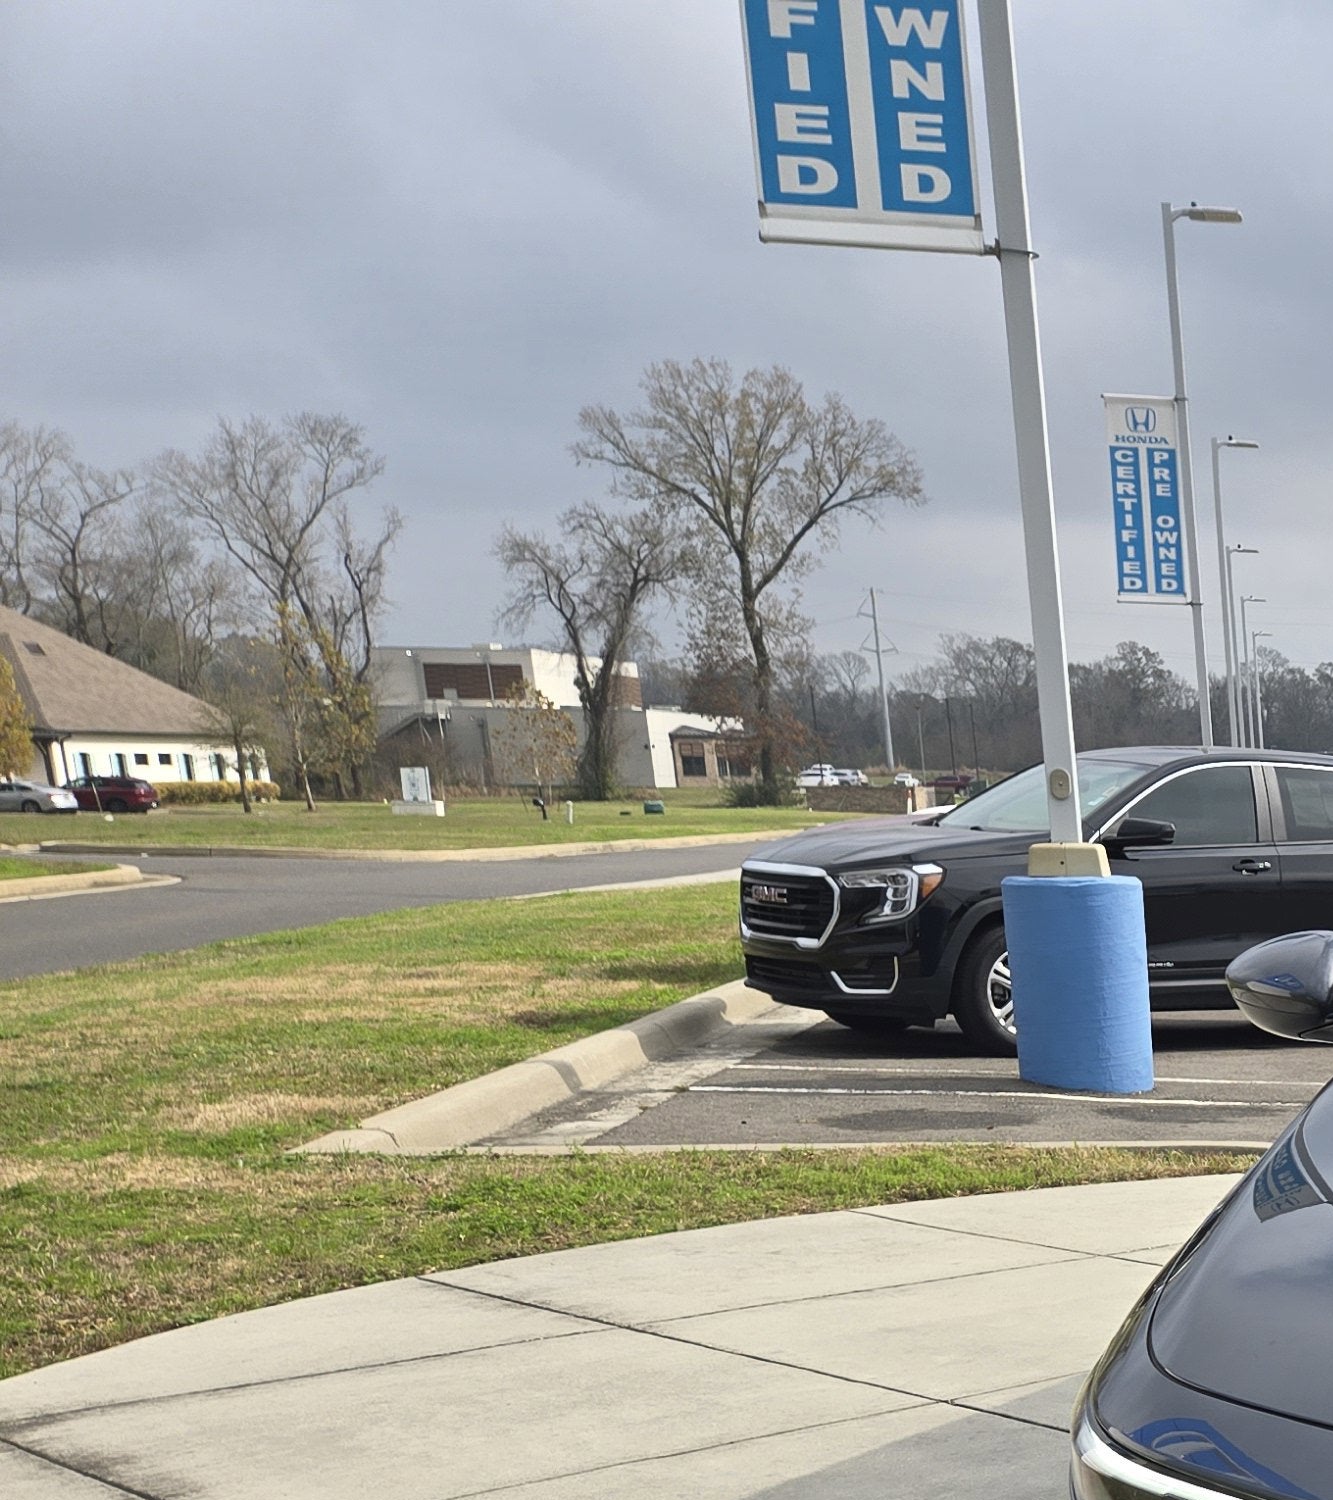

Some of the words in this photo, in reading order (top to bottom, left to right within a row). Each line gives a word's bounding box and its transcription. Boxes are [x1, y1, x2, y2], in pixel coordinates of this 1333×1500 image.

[1114, 434, 1169, 445] HONDA
[1153, 451, 1171, 496] PRE
[1114, 450, 1142, 590] CERTIFIED
[1155, 515, 1178, 591] OWNED
[751, 885, 788, 904] GMC
